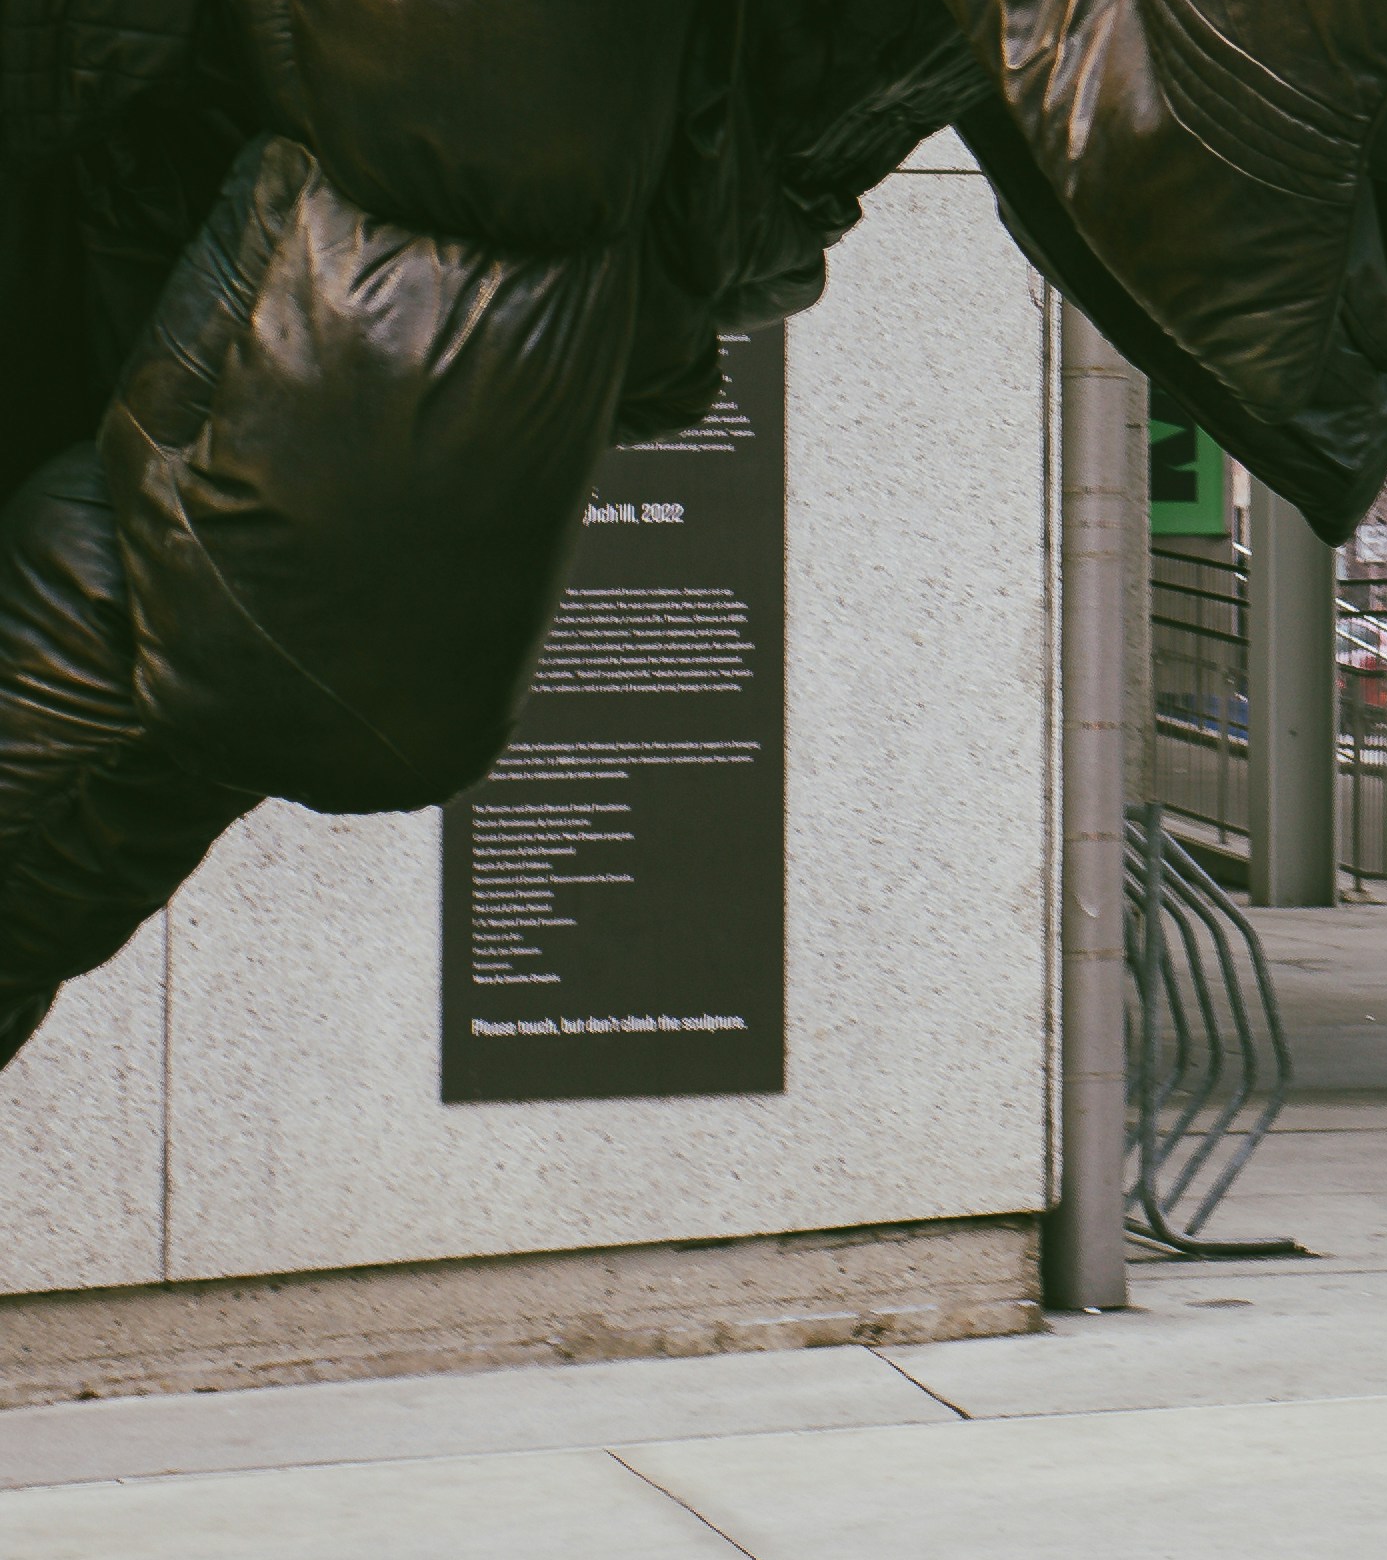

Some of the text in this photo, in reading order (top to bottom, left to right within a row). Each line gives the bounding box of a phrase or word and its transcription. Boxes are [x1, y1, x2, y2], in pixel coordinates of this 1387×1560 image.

[641, 503, 685, 523] 2022
[471, 1013, 748, 1036] Please touch, but don't climb the sculpture.
